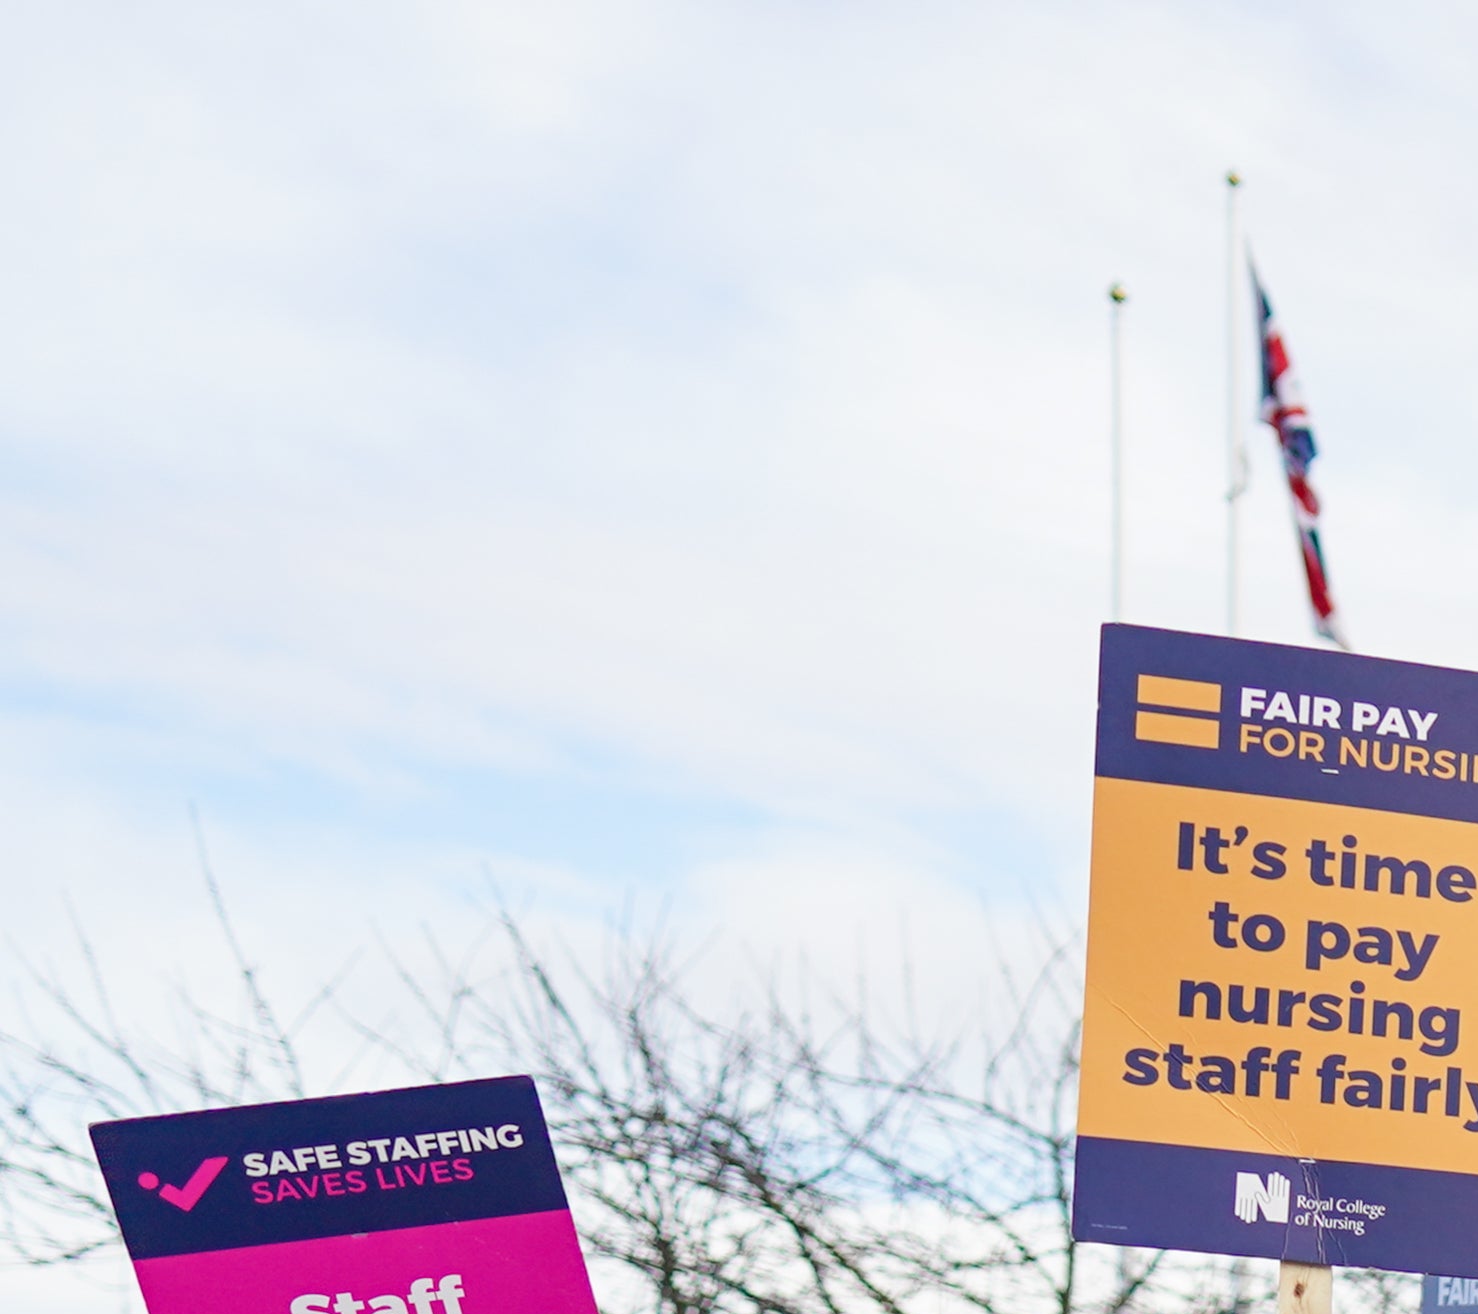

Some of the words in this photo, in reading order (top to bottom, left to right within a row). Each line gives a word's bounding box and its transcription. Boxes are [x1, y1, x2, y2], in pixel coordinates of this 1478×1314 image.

[1241, 686, 1342, 732] FAIR
[1353, 701, 1438, 741] PAY
[1240, 725, 1324, 762] FOR
[1305, 835, 1477, 902] time
[1208, 901, 1285, 951] to
[1305, 920, 1439, 981] pay
[1178, 978, 1460, 1057] nursing
[1123, 1042, 1300, 1100] staff
[244, 1142, 343, 1177] SAFE
[347, 1124, 524, 1169] STAFFING
[252, 1173, 368, 1205] SAVES
[378, 1160, 473, 1193] LIVES
[1297, 1196, 1333, 1215] Royal
[1336, 1198, 1386, 1221] College
[1295, 1211, 1311, 1227] of
[1313, 1213, 1365, 1235] Nursing
